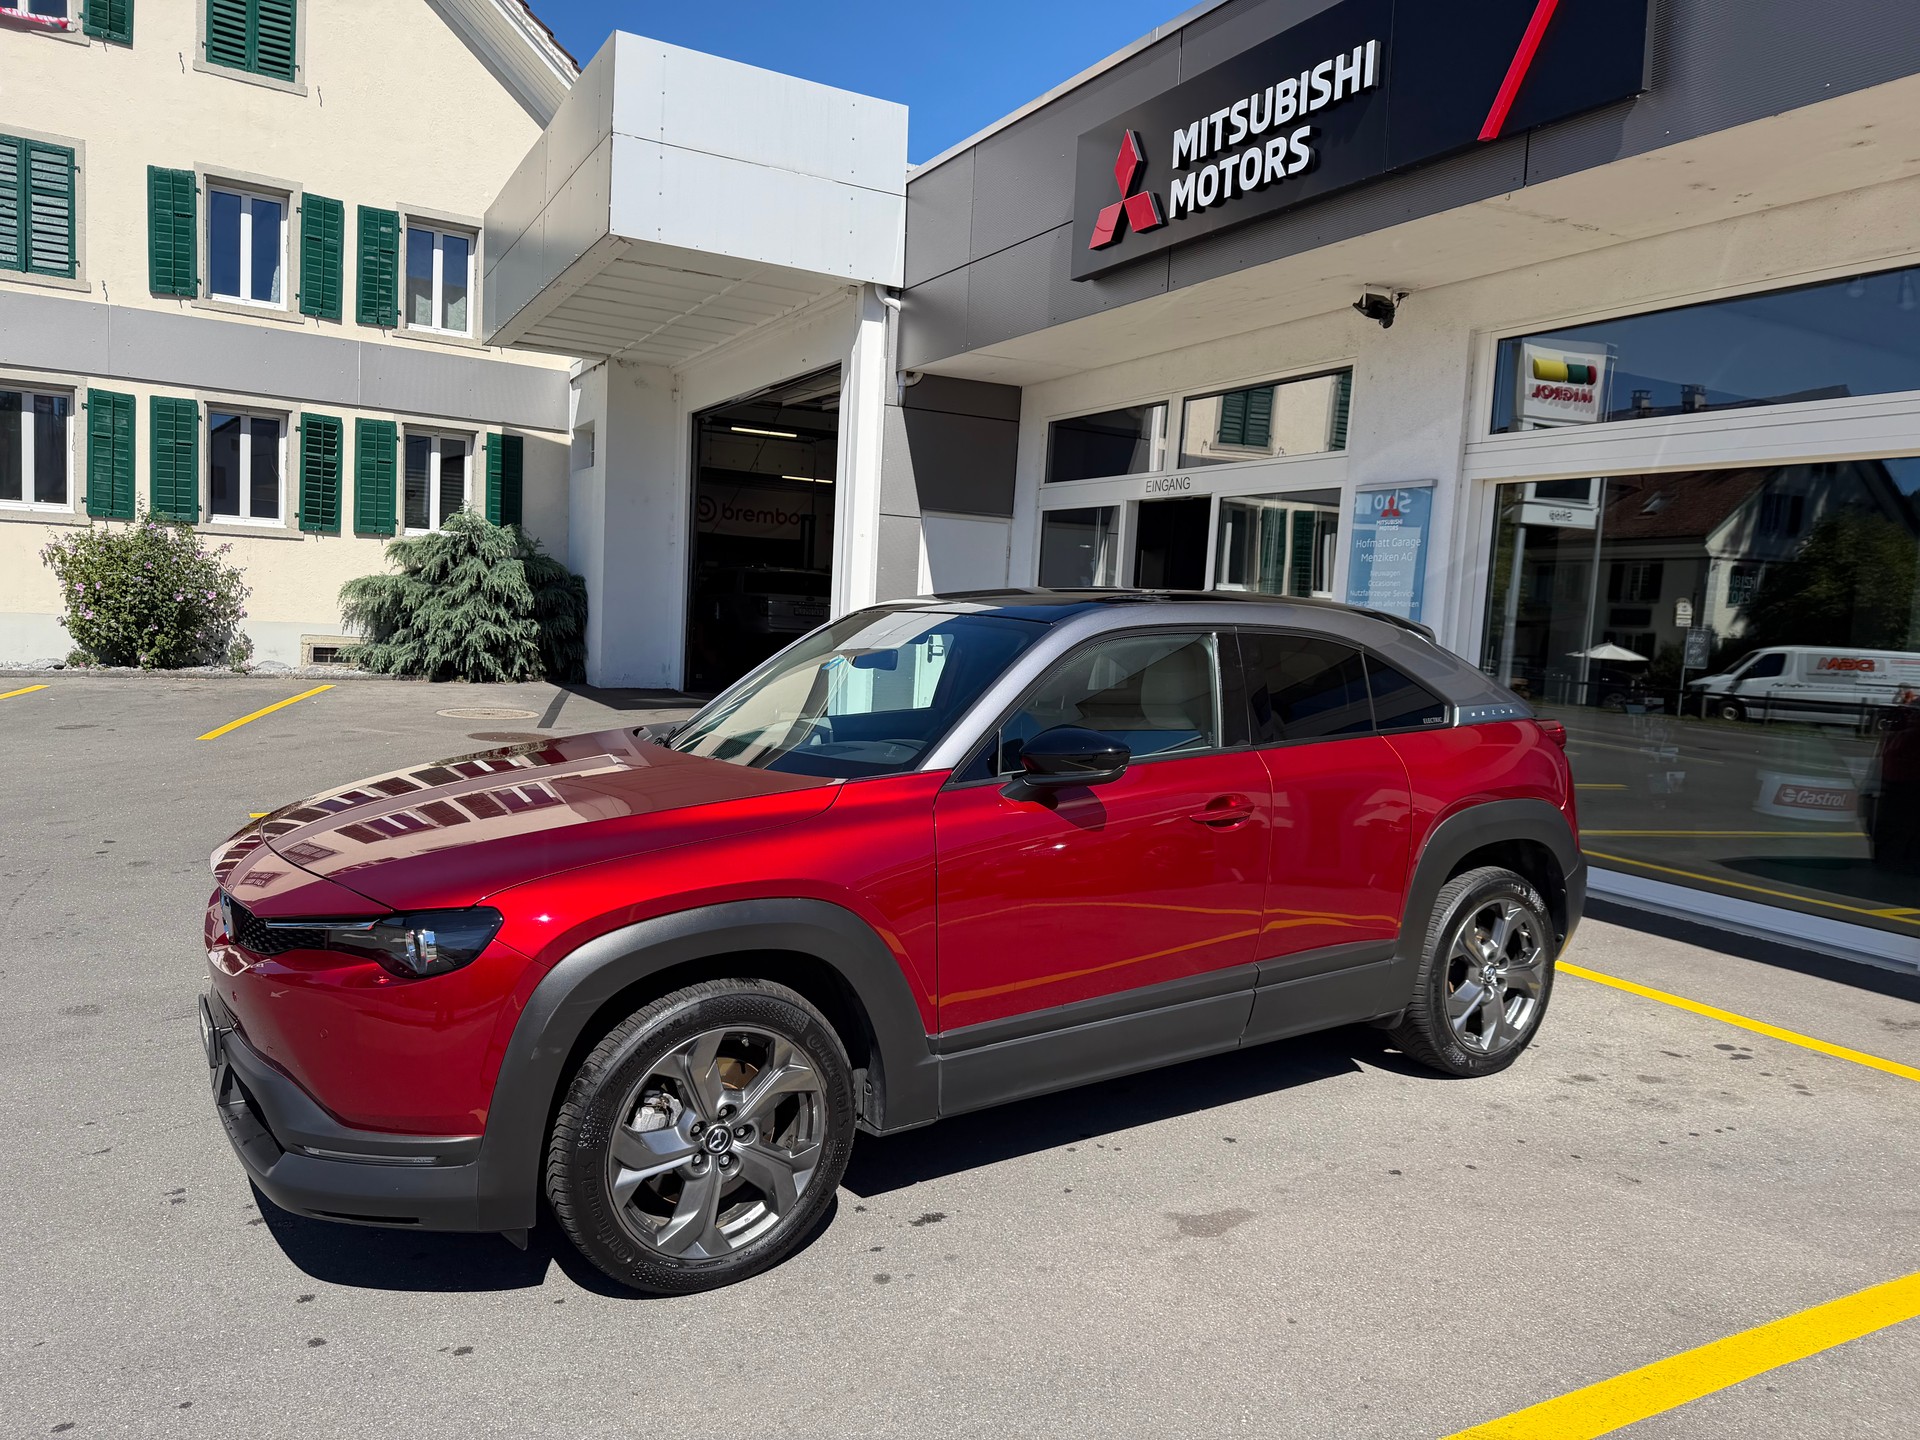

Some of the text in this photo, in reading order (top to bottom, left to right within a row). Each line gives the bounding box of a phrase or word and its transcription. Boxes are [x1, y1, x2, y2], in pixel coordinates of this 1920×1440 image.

[1171, 39, 1381, 170] MITSUBISHI
[1169, 126, 1315, 220] MOTORS
[1145, 476, 1191, 493] EINGANG
[722, 502, 801, 525] brembo
[1355, 537, 1422, 549] Hofmatt Garage
[1360, 552, 1413, 563] Menziken AG
[1796, 790, 1847, 806] Castrol
